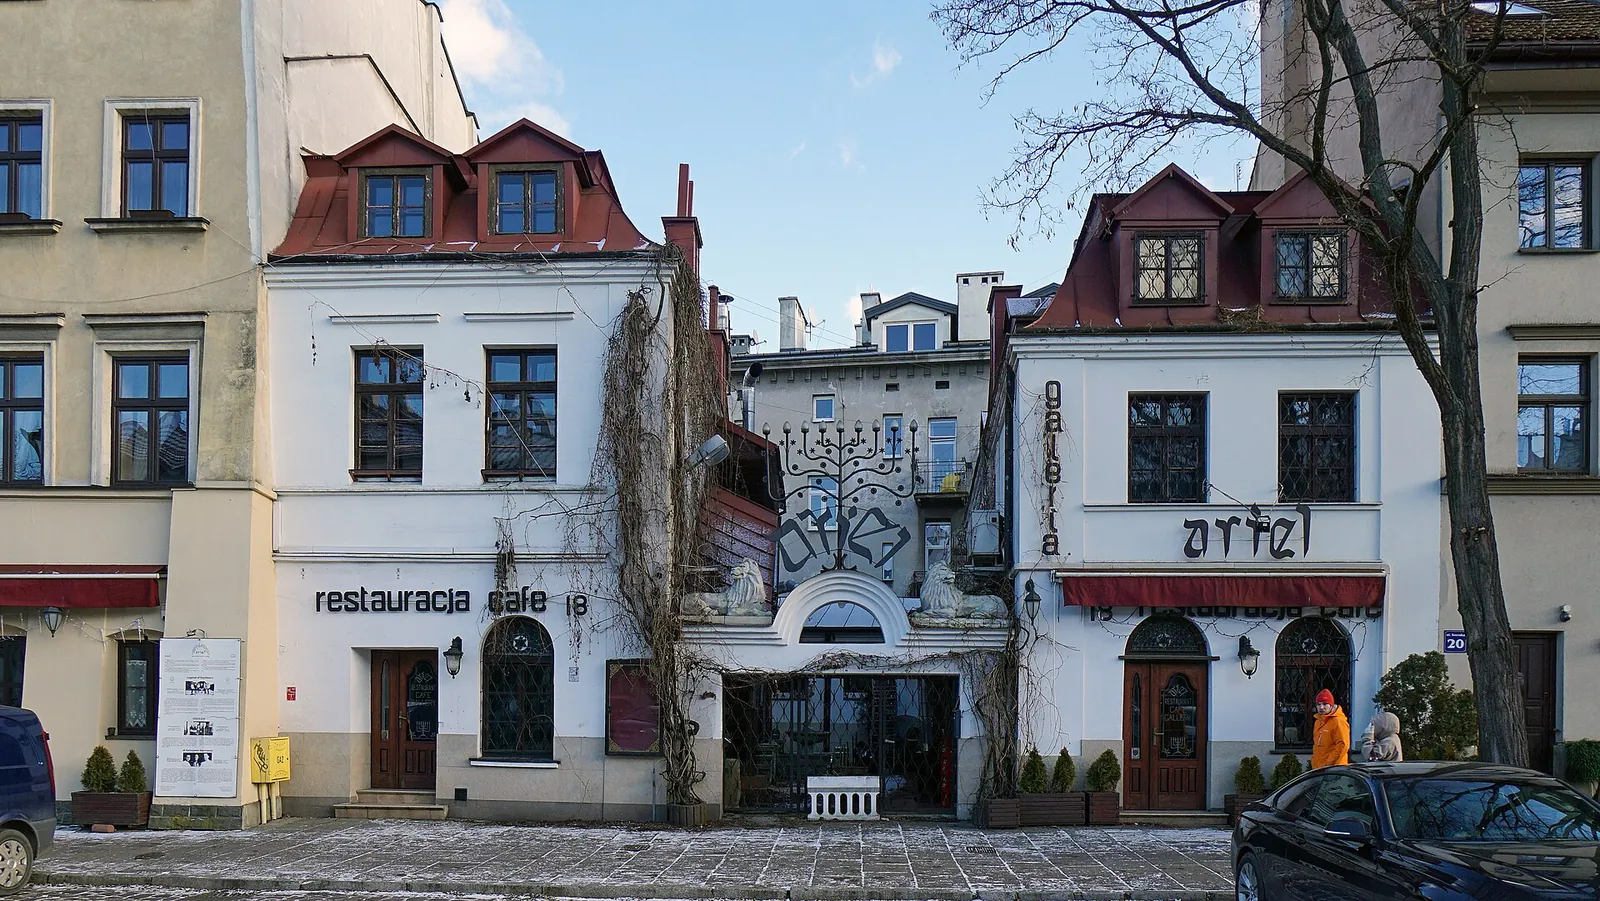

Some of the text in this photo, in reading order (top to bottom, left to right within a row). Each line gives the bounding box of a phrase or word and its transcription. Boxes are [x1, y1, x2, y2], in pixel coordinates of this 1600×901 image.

[1042, 380, 1063, 555] galeria
[1183, 503, 1312, 559] ariel
[315, 586, 588, 616] restauracja cafe 18
[1447, 638, 1465, 648] 20
